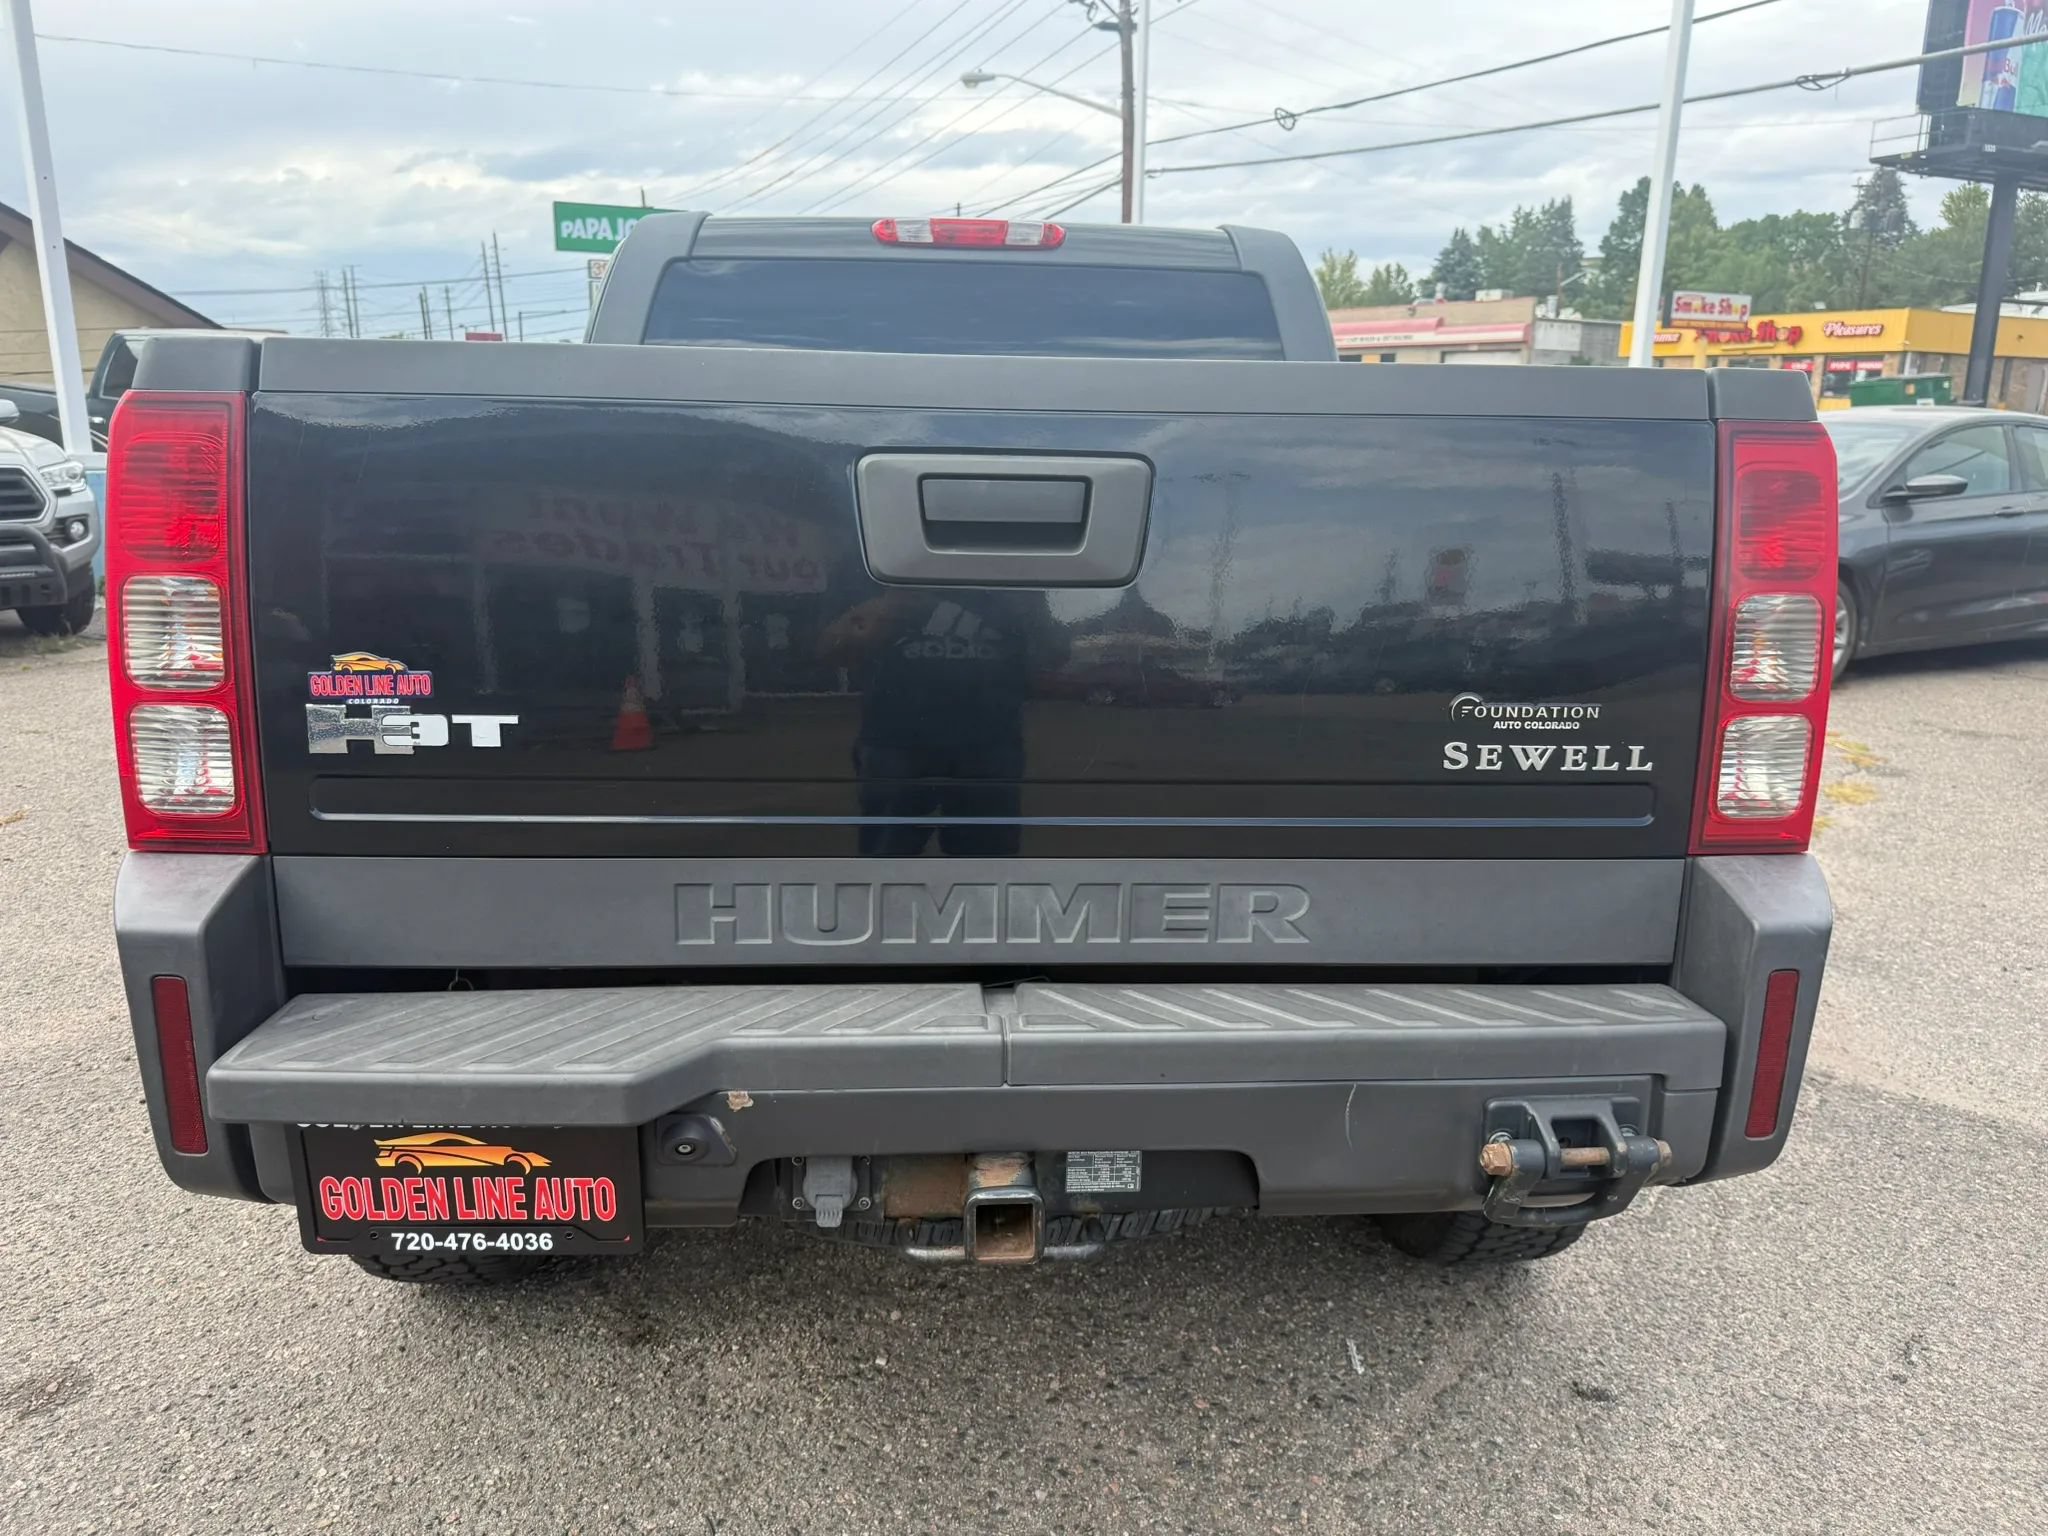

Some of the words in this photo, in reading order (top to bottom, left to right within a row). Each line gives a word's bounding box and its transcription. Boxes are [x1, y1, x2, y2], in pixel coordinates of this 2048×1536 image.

[561, 217, 614, 240] PAPA
[1674, 296, 1715, 314] Smoke
[1718, 297, 1748, 320] Shop
[1756, 320, 1802, 346] Shop
[1824, 322, 1883, 337] Pleasures
[311, 675, 363, 696] GOLDEN
[365, 676, 395, 696] LINE
[397, 674, 432, 696] AUTO
[1451, 695, 1600, 721] FOUNDATION
[305, 703, 519, 755] H3T
[1493, 720, 1522, 730] AUTO
[1524, 720, 1580, 730] COLORADO
[1443, 741, 1653, 772] SEWELL
[674, 882, 1311, 946] HUMMER
[319, 1175, 450, 1221] GOLDEN
[453, 1176, 528, 1221] LINE
[533, 1176, 617, 1222] AUTO
[391, 1232, 554, 1252] 720-476-4036
